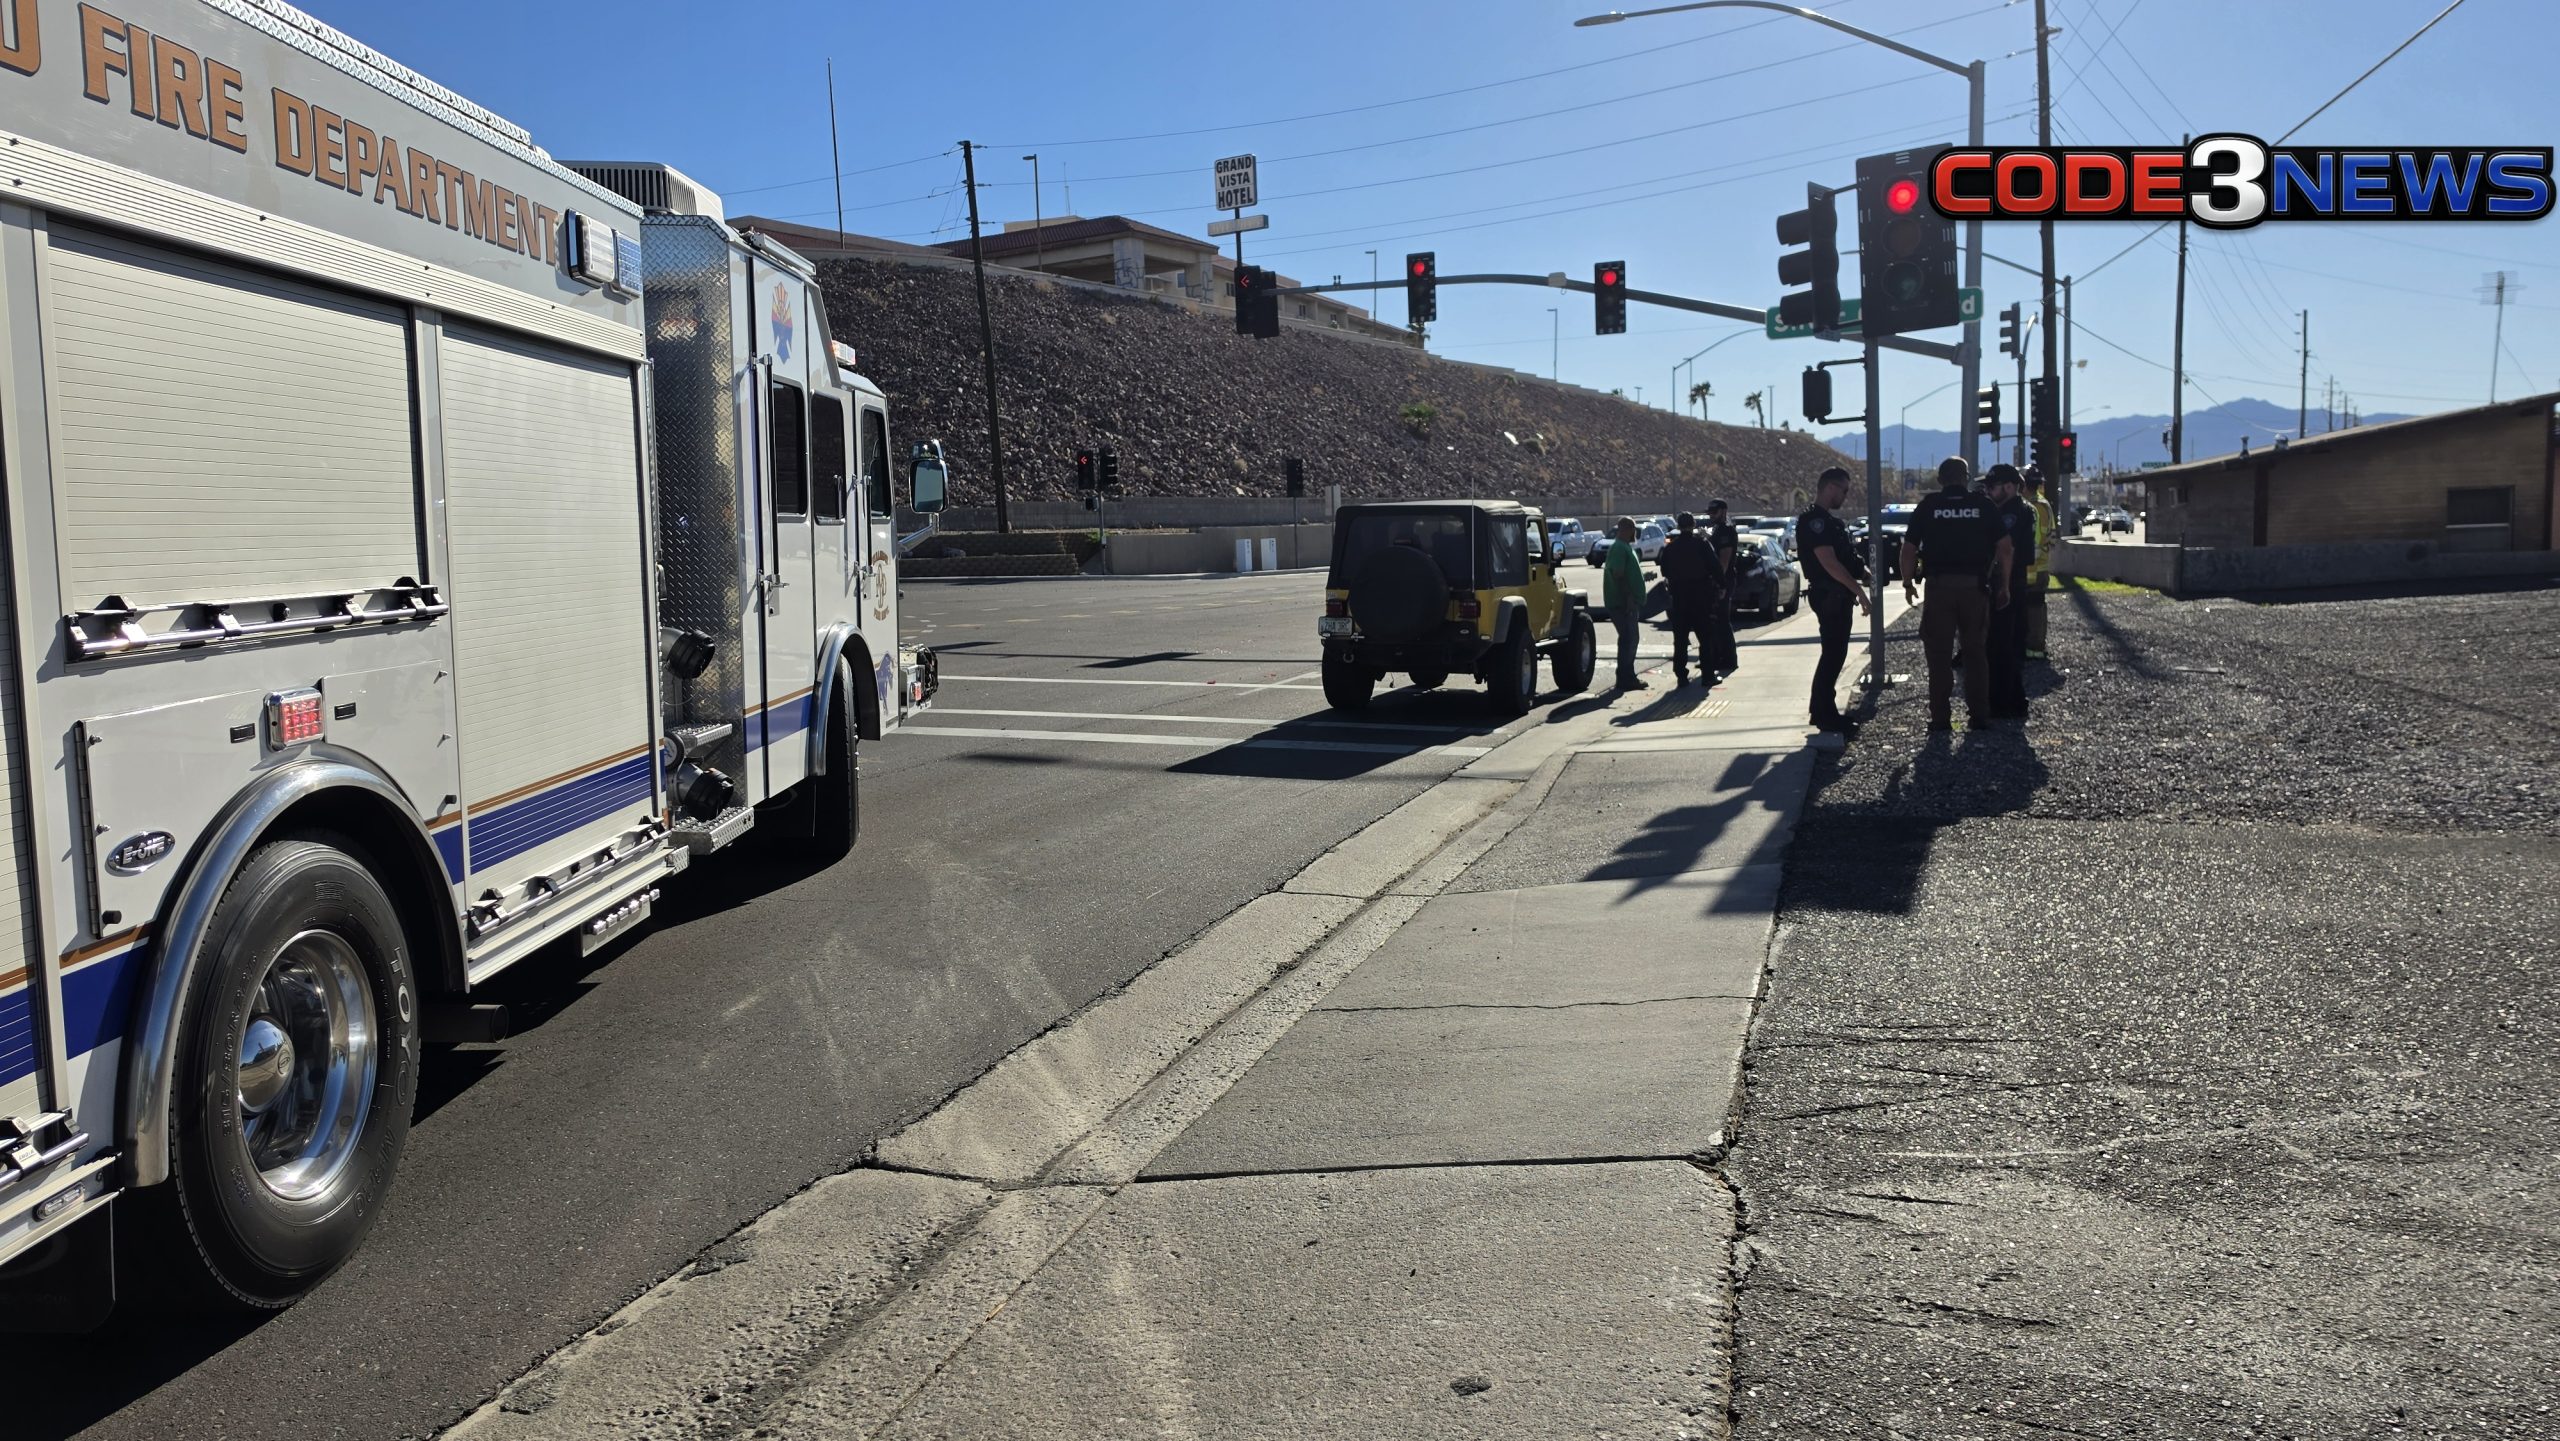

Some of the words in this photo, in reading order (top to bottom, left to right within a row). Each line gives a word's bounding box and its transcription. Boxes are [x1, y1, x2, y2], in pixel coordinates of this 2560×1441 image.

[77, 2, 247, 154] FIRE
[272, 87, 558, 267] DEPARTMENT
[1216, 156, 1252, 173] GRAND
[1219, 172, 1250, 188] VISTA
[1217, 187, 1253, 208] HOTEL
[1934, 508, 1980, 519] POLICE
[123, 836, 165, 865] E-ONE
[390, 947, 411, 1105] TOYO
